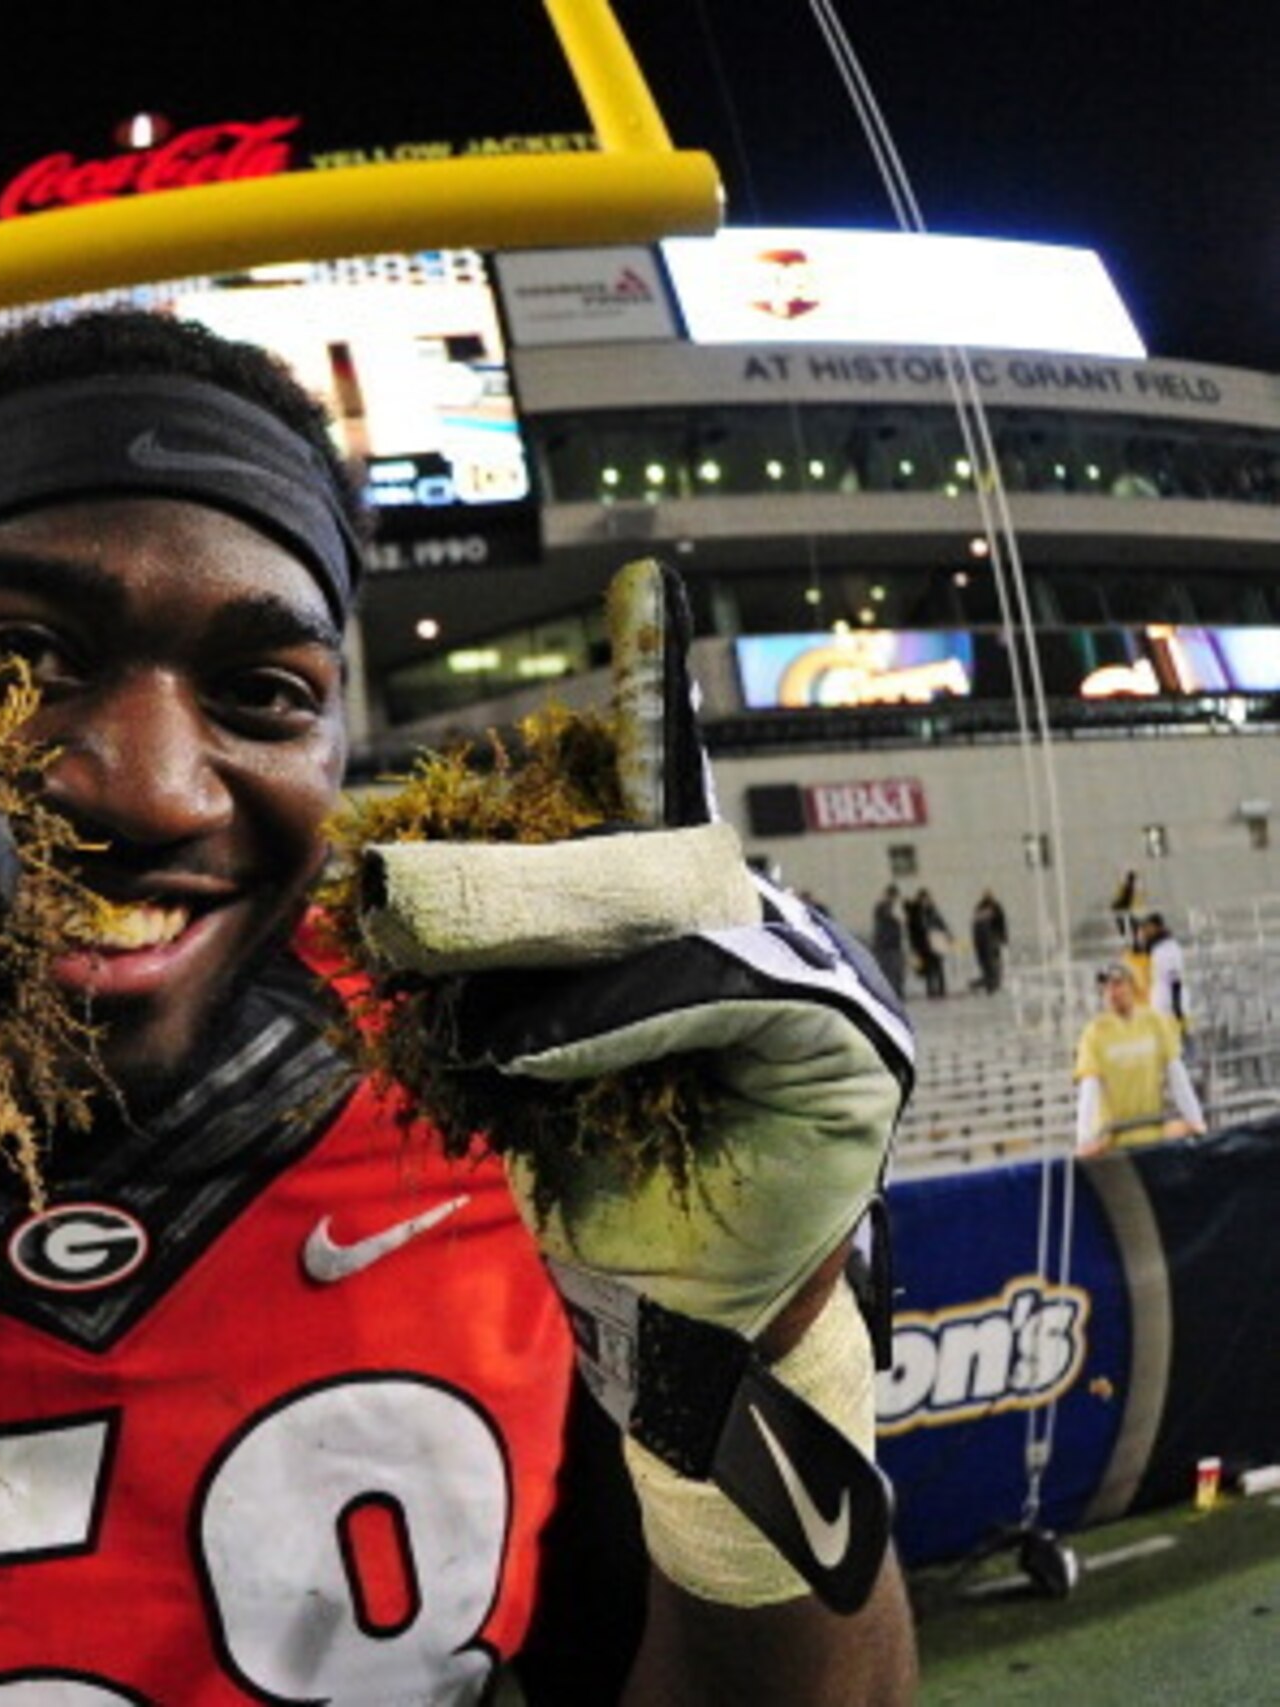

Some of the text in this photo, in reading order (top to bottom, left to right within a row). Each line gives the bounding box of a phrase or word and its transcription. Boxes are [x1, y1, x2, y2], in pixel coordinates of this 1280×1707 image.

[744, 354, 791, 382] AT
[1008, 361, 1122, 393] GRANT
[1133, 370, 1221, 403] FIELD
[14, 1209, 143, 1285] G
[875, 1291, 1075, 1420] on's
